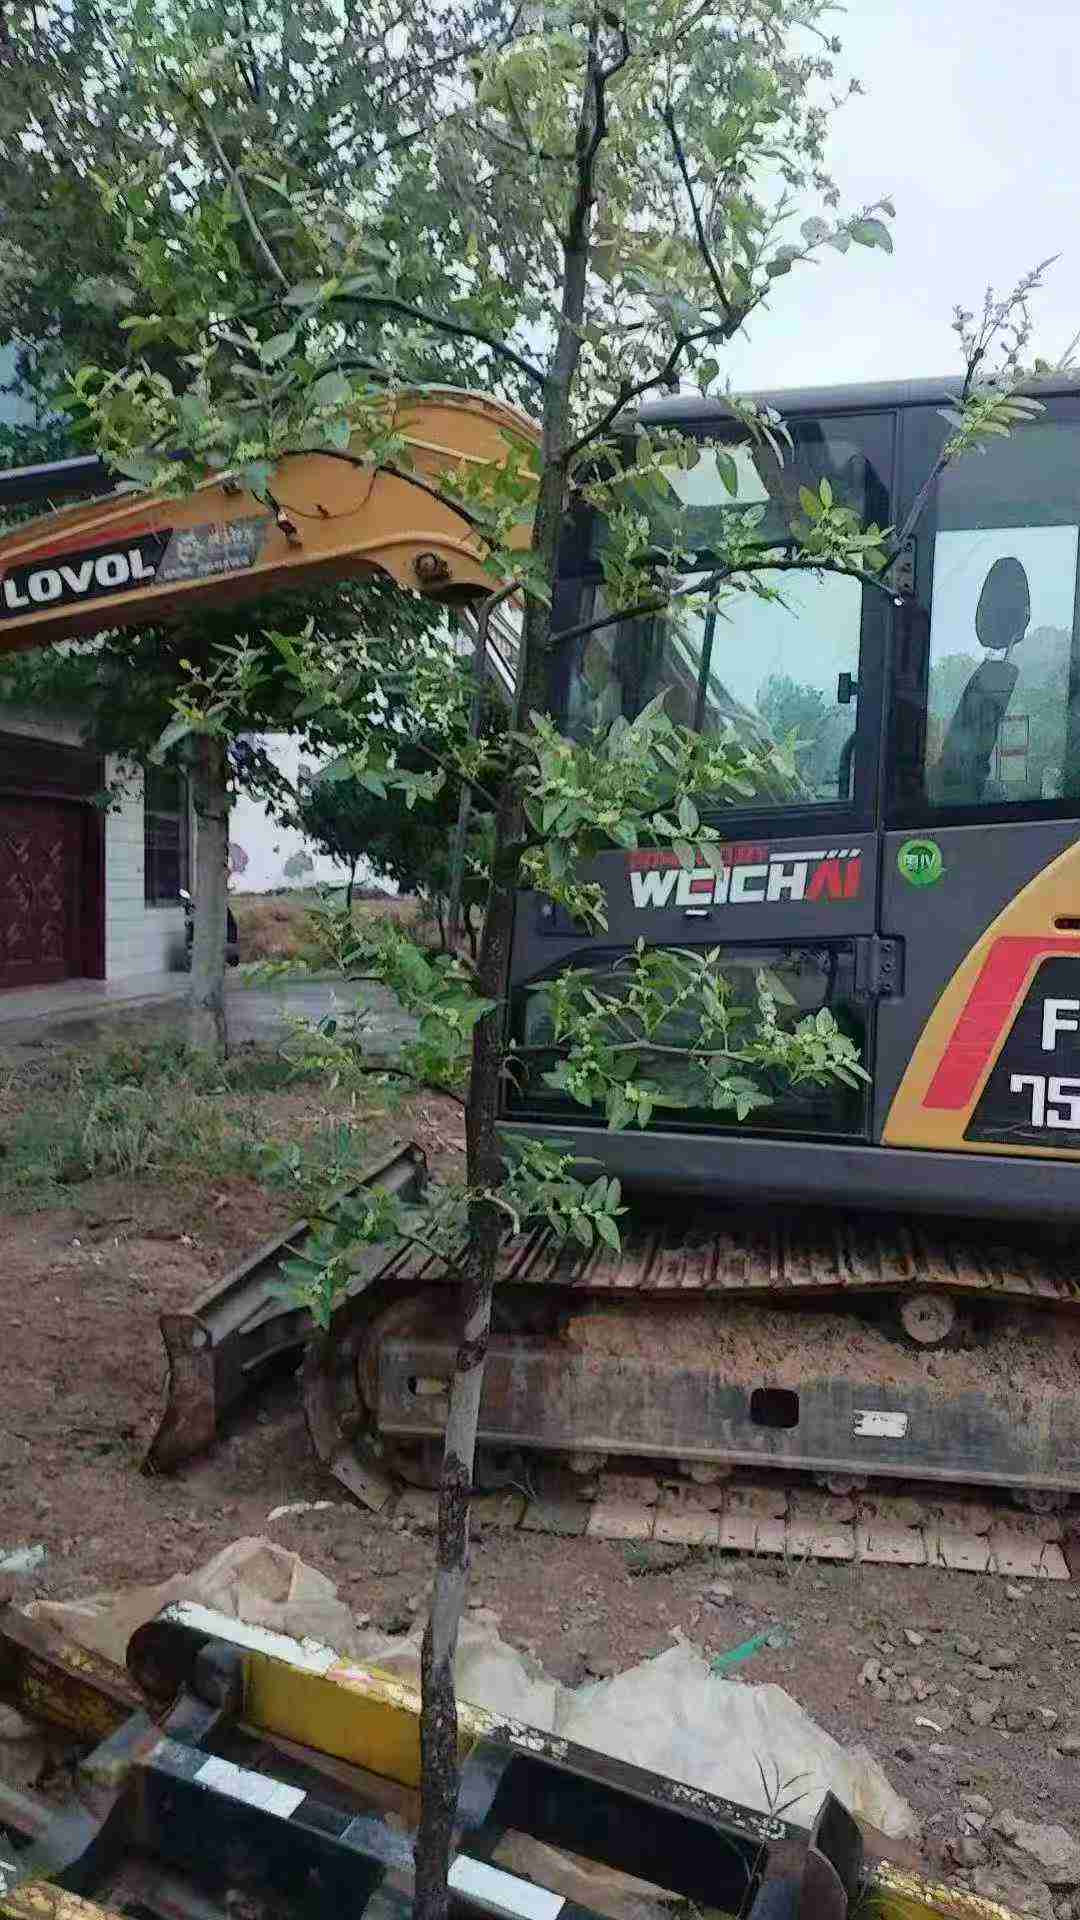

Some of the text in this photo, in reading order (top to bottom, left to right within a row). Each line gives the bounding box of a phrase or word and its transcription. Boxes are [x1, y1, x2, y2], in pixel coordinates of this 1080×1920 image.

[3, 549, 155, 608] LOVOL
[630, 858, 862, 907] WEICHAI
[1042, 998, 1080, 1050] F
[1010, 1074, 1080, 1129] 75
